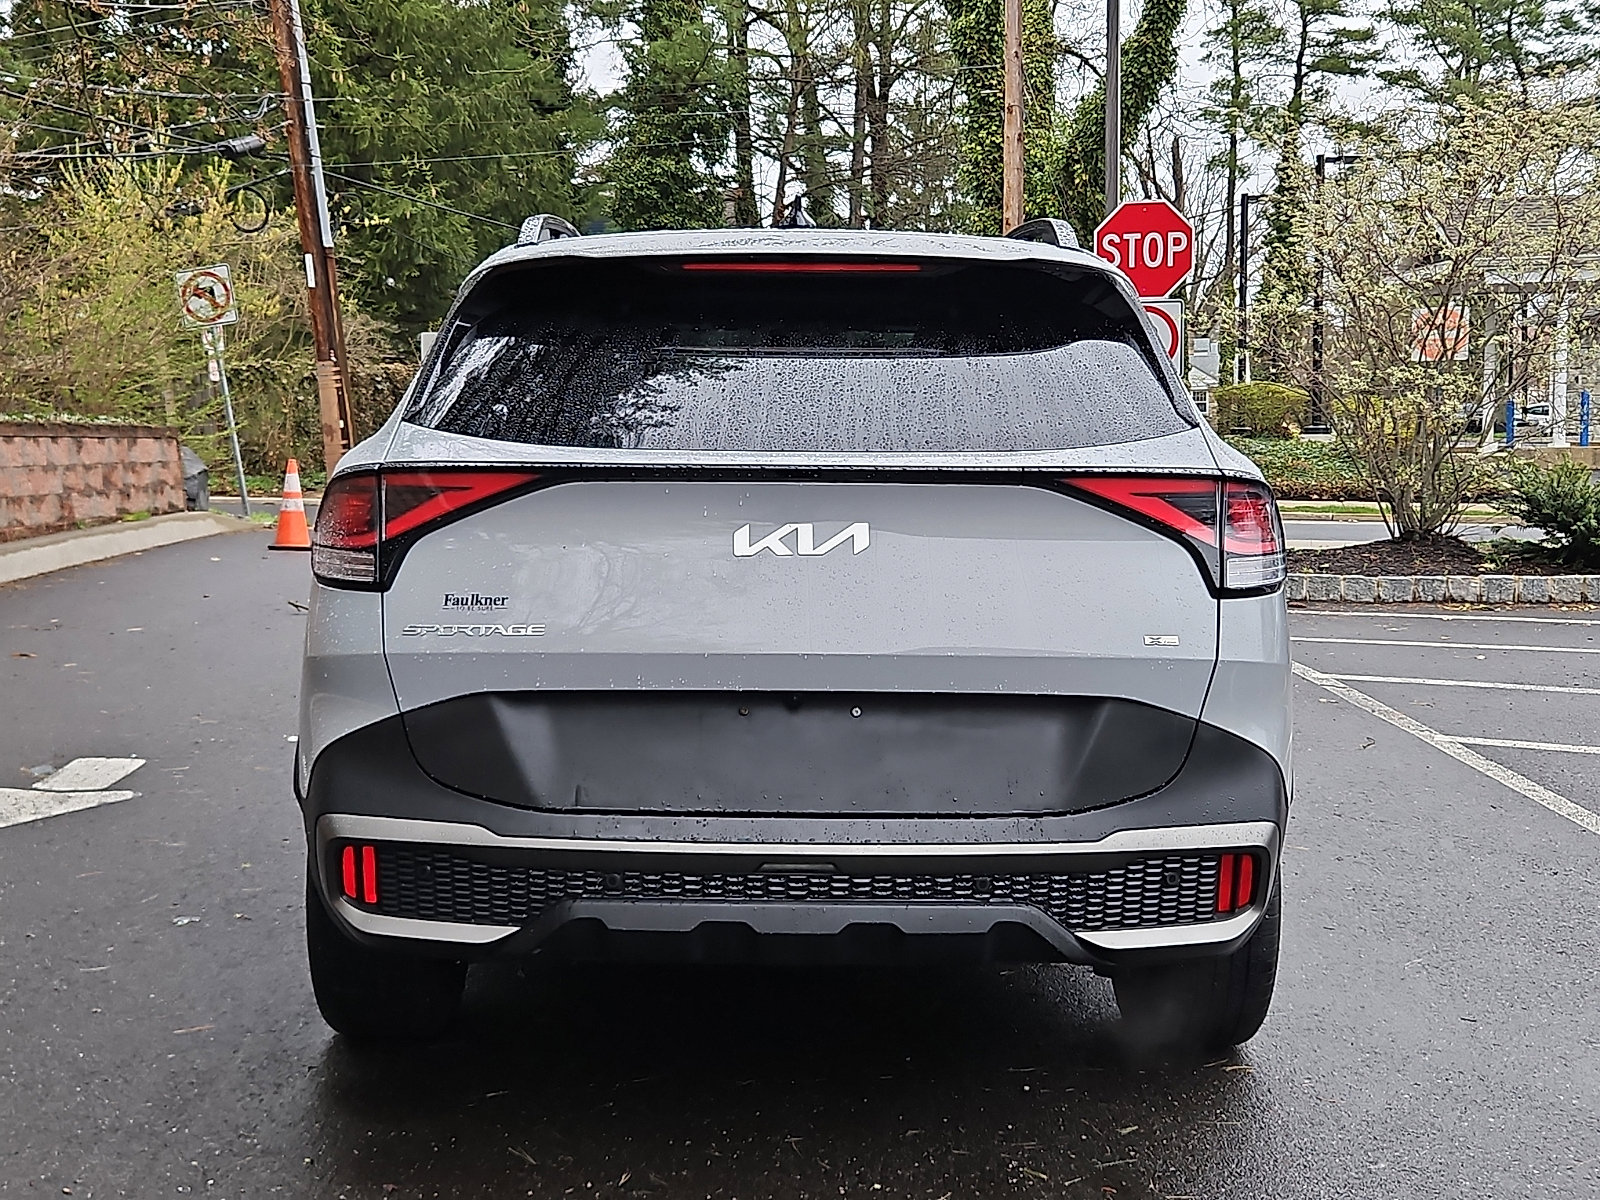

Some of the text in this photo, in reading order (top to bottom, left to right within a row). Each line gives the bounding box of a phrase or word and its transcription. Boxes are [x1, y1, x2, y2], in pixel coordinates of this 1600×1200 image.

[1102, 231, 1188, 269] STOP
[733, 522, 870, 557] KIA
[443, 593, 509, 606] Faulkner
[402, 624, 546, 636] SPORTAGE
